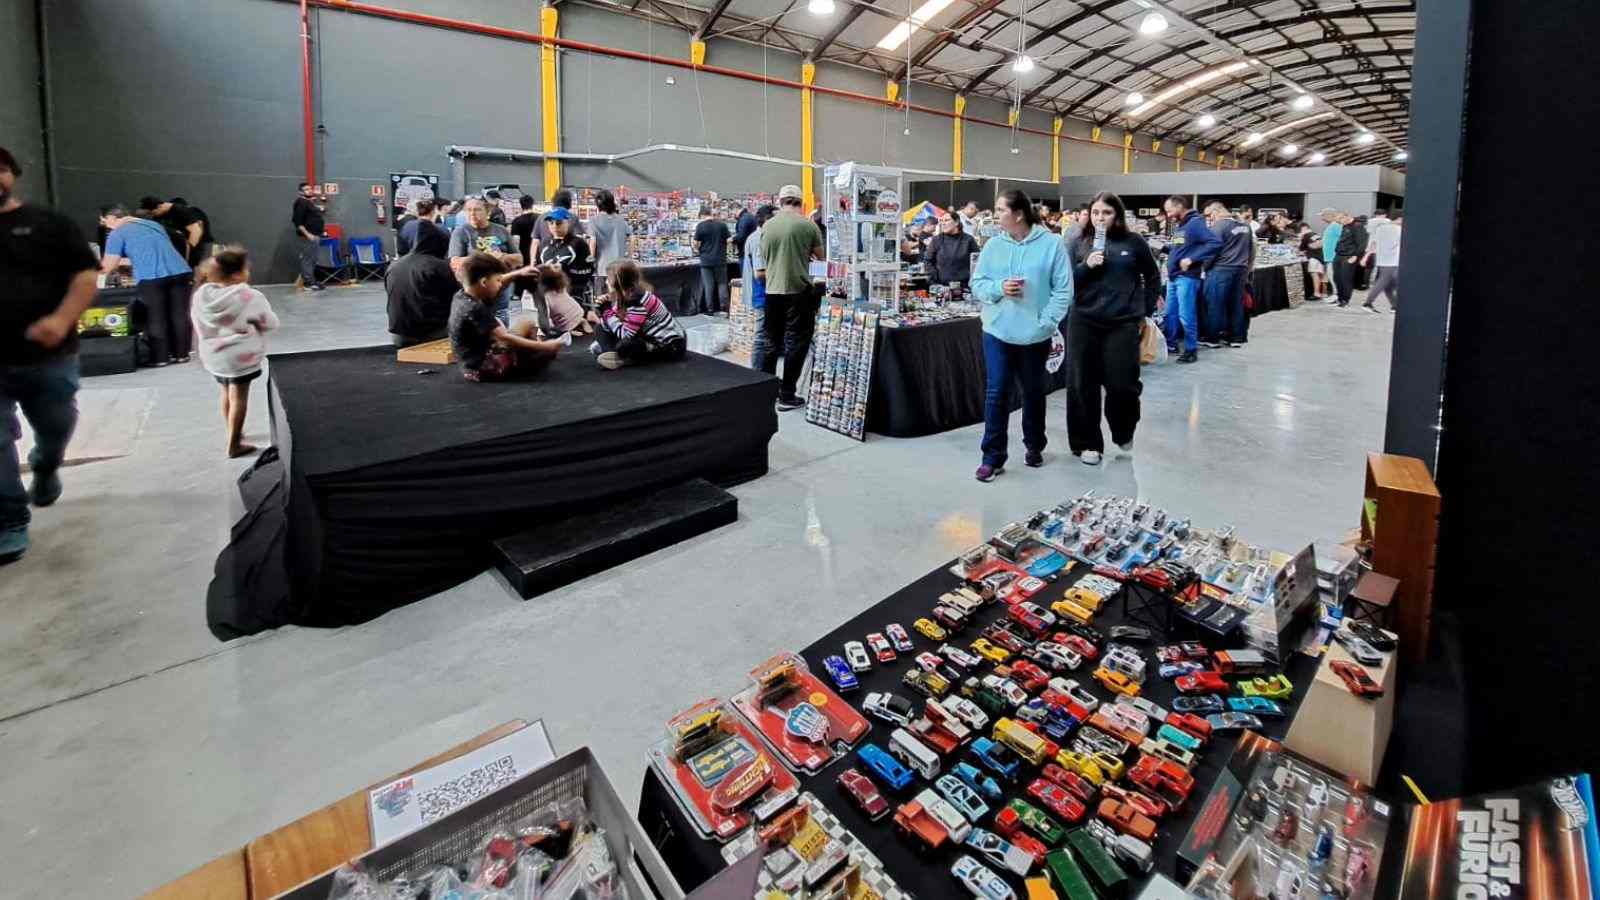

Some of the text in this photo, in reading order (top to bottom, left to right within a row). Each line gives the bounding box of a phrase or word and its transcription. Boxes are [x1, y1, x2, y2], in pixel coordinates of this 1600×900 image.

[1456, 811, 1490, 900] FURIO
[1484, 798, 1520, 898] FAST &
